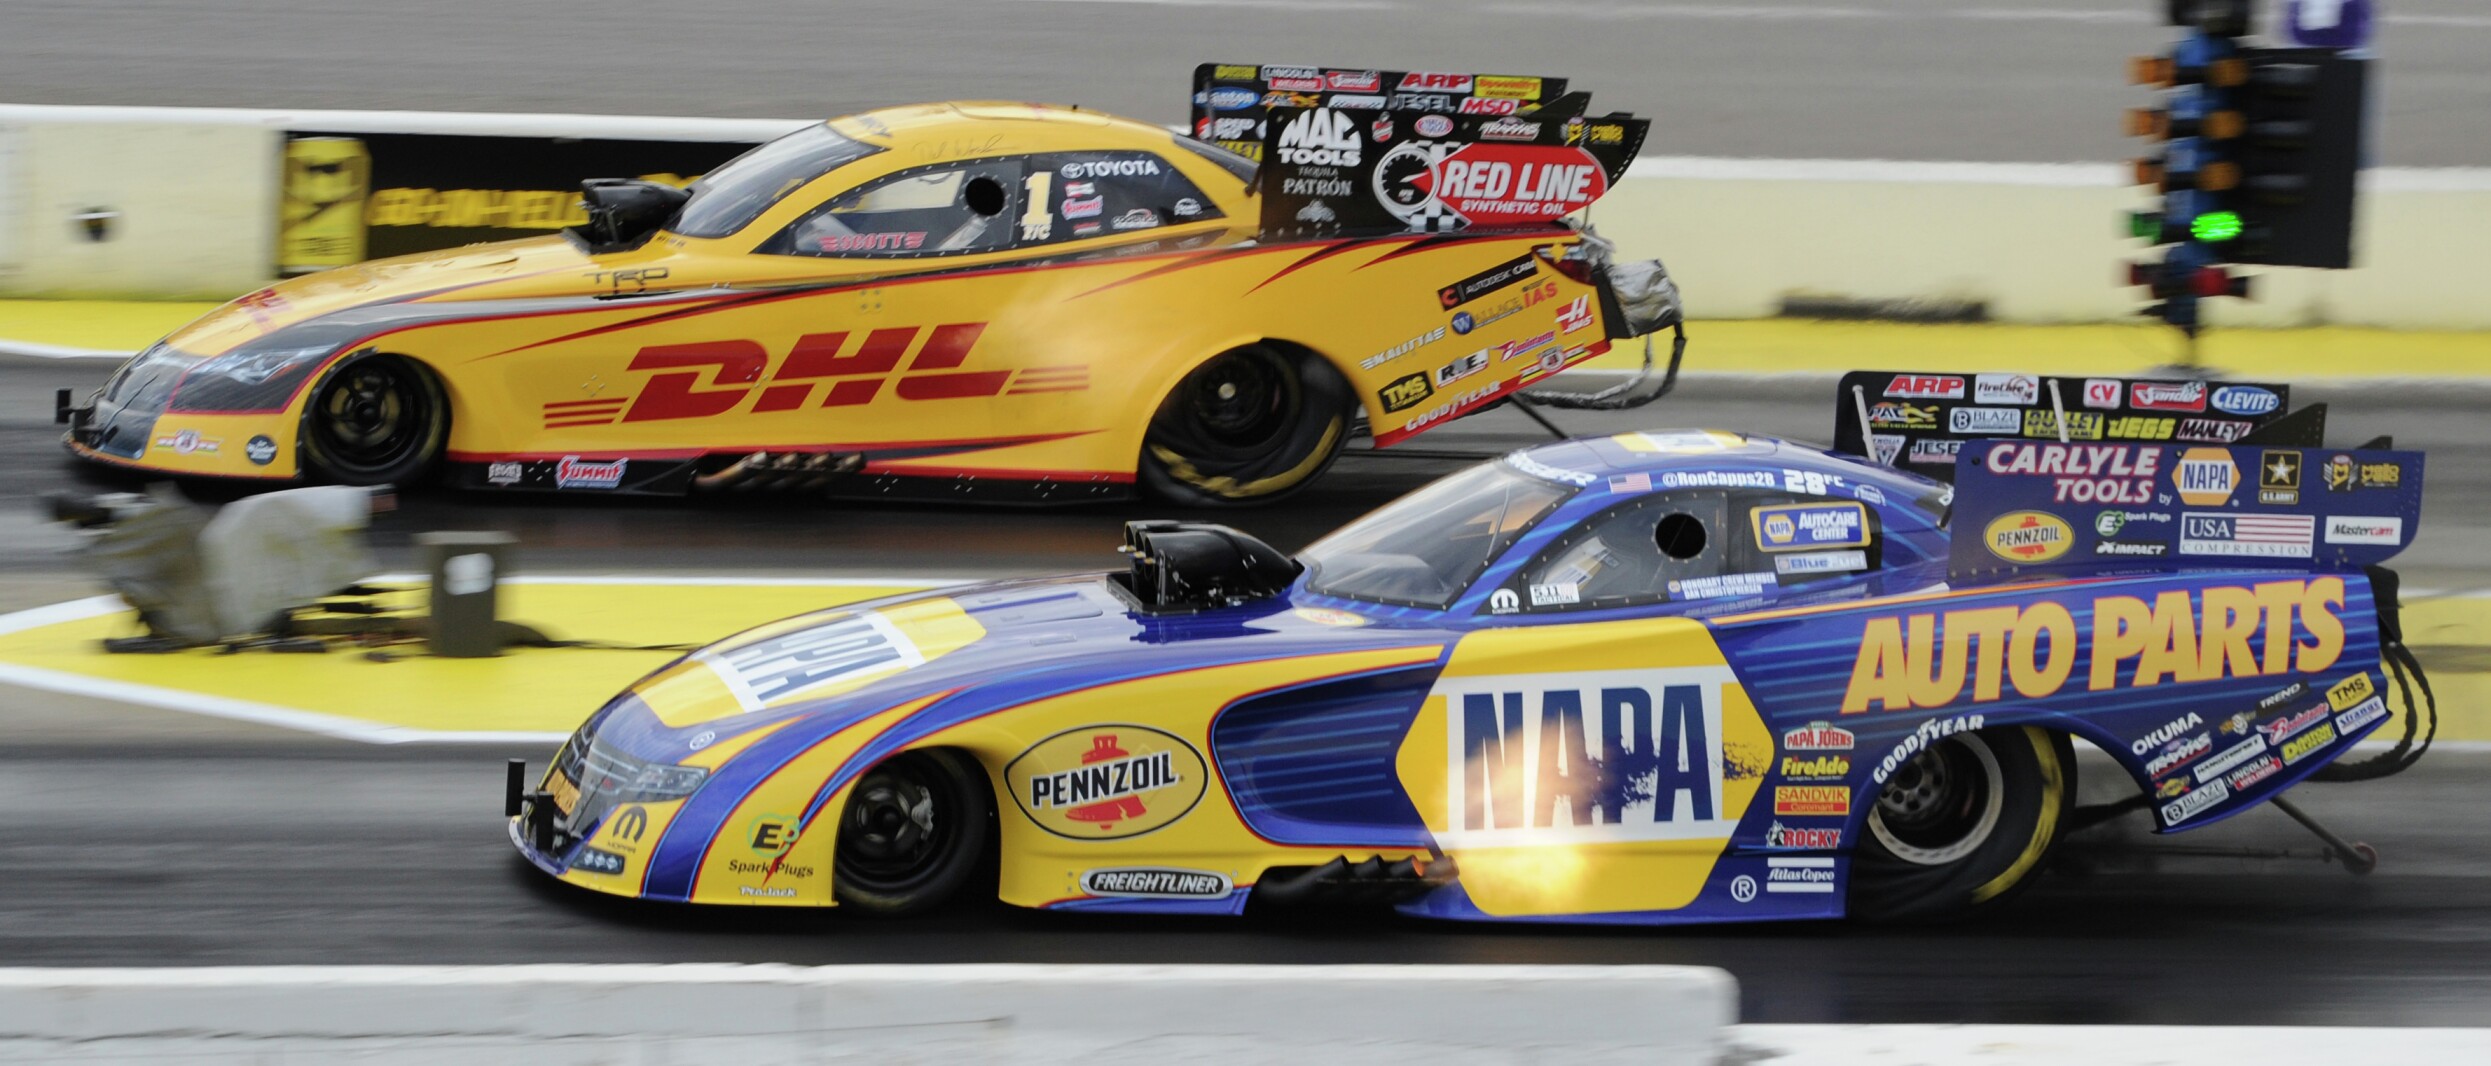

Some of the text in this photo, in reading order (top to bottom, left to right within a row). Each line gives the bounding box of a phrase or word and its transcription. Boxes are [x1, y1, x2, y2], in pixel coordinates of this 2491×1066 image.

[1403, 74, 1472, 88] ARP
[1462, 99, 1515, 115] MSD
[1278, 107, 1363, 149] MAC
[1084, 159, 1161, 178] TOYOTA
[1277, 149, 1362, 167] TOOLS
[1439, 160, 1596, 203] RED LINE
[1020, 171, 1054, 227] 1
[1460, 200, 1566, 215] SYNTHETIC OIL
[582, 266, 669, 297] TRD
[1524, 281, 1559, 308] IAS
[620, 321, 1014, 422] DHL
[1383, 374, 1428, 404] TMS
[1886, 376, 1965, 395] ARP
[2090, 384, 2116, 401] CV
[1405, 380, 1501, 432] GOODYEAR
[2211, 386, 2277, 411] CLEVITE
[1973, 409, 2018, 422] BLAZE
[2108, 416, 2176, 440] JEGS
[1986, 444, 2161, 476] CARLYLE
[1662, 471, 1775, 488] @RonCapps28
[1783, 468, 1828, 496] 28
[2183, 463, 2230, 490] NAPA
[2053, 478, 2173, 506] TOOLS by
[1769, 520, 1792, 535] NAPA
[1812, 526, 1849, 541] CENTER
[1997, 525, 2061, 548] PENNZOIL
[2188, 518, 2231, 538] USA
[2333, 523, 2394, 537] Mastercam
[2182, 543, 2311, 556] COMPRESSION
[1838, 577, 2346, 714] AUTO PARTS
[2260, 683, 2301, 709] TREND
[2332, 678, 2366, 702] TMS
[1786, 731, 1815, 748] PAPA
[2132, 711, 2204, 756] OKUMA
[1463, 684, 1714, 832] NAPA
[1873, 714, 1985, 784] GOODYEAR
[1781, 755, 1850, 777] FireAde
[2227, 754, 2272, 784] LINCOLN
[1032, 752, 1177, 807] PENNZOIL
[1778, 787, 1847, 801] SANDVIK
[1790, 802, 1835, 812] Coromant
[1783, 829, 1841, 849] ROCKY
[728, 859, 814, 878] Spark Plugs
[1768, 867, 1835, 883] Atlas Copco
[1094, 871, 1219, 893] FREIGHTLINER
